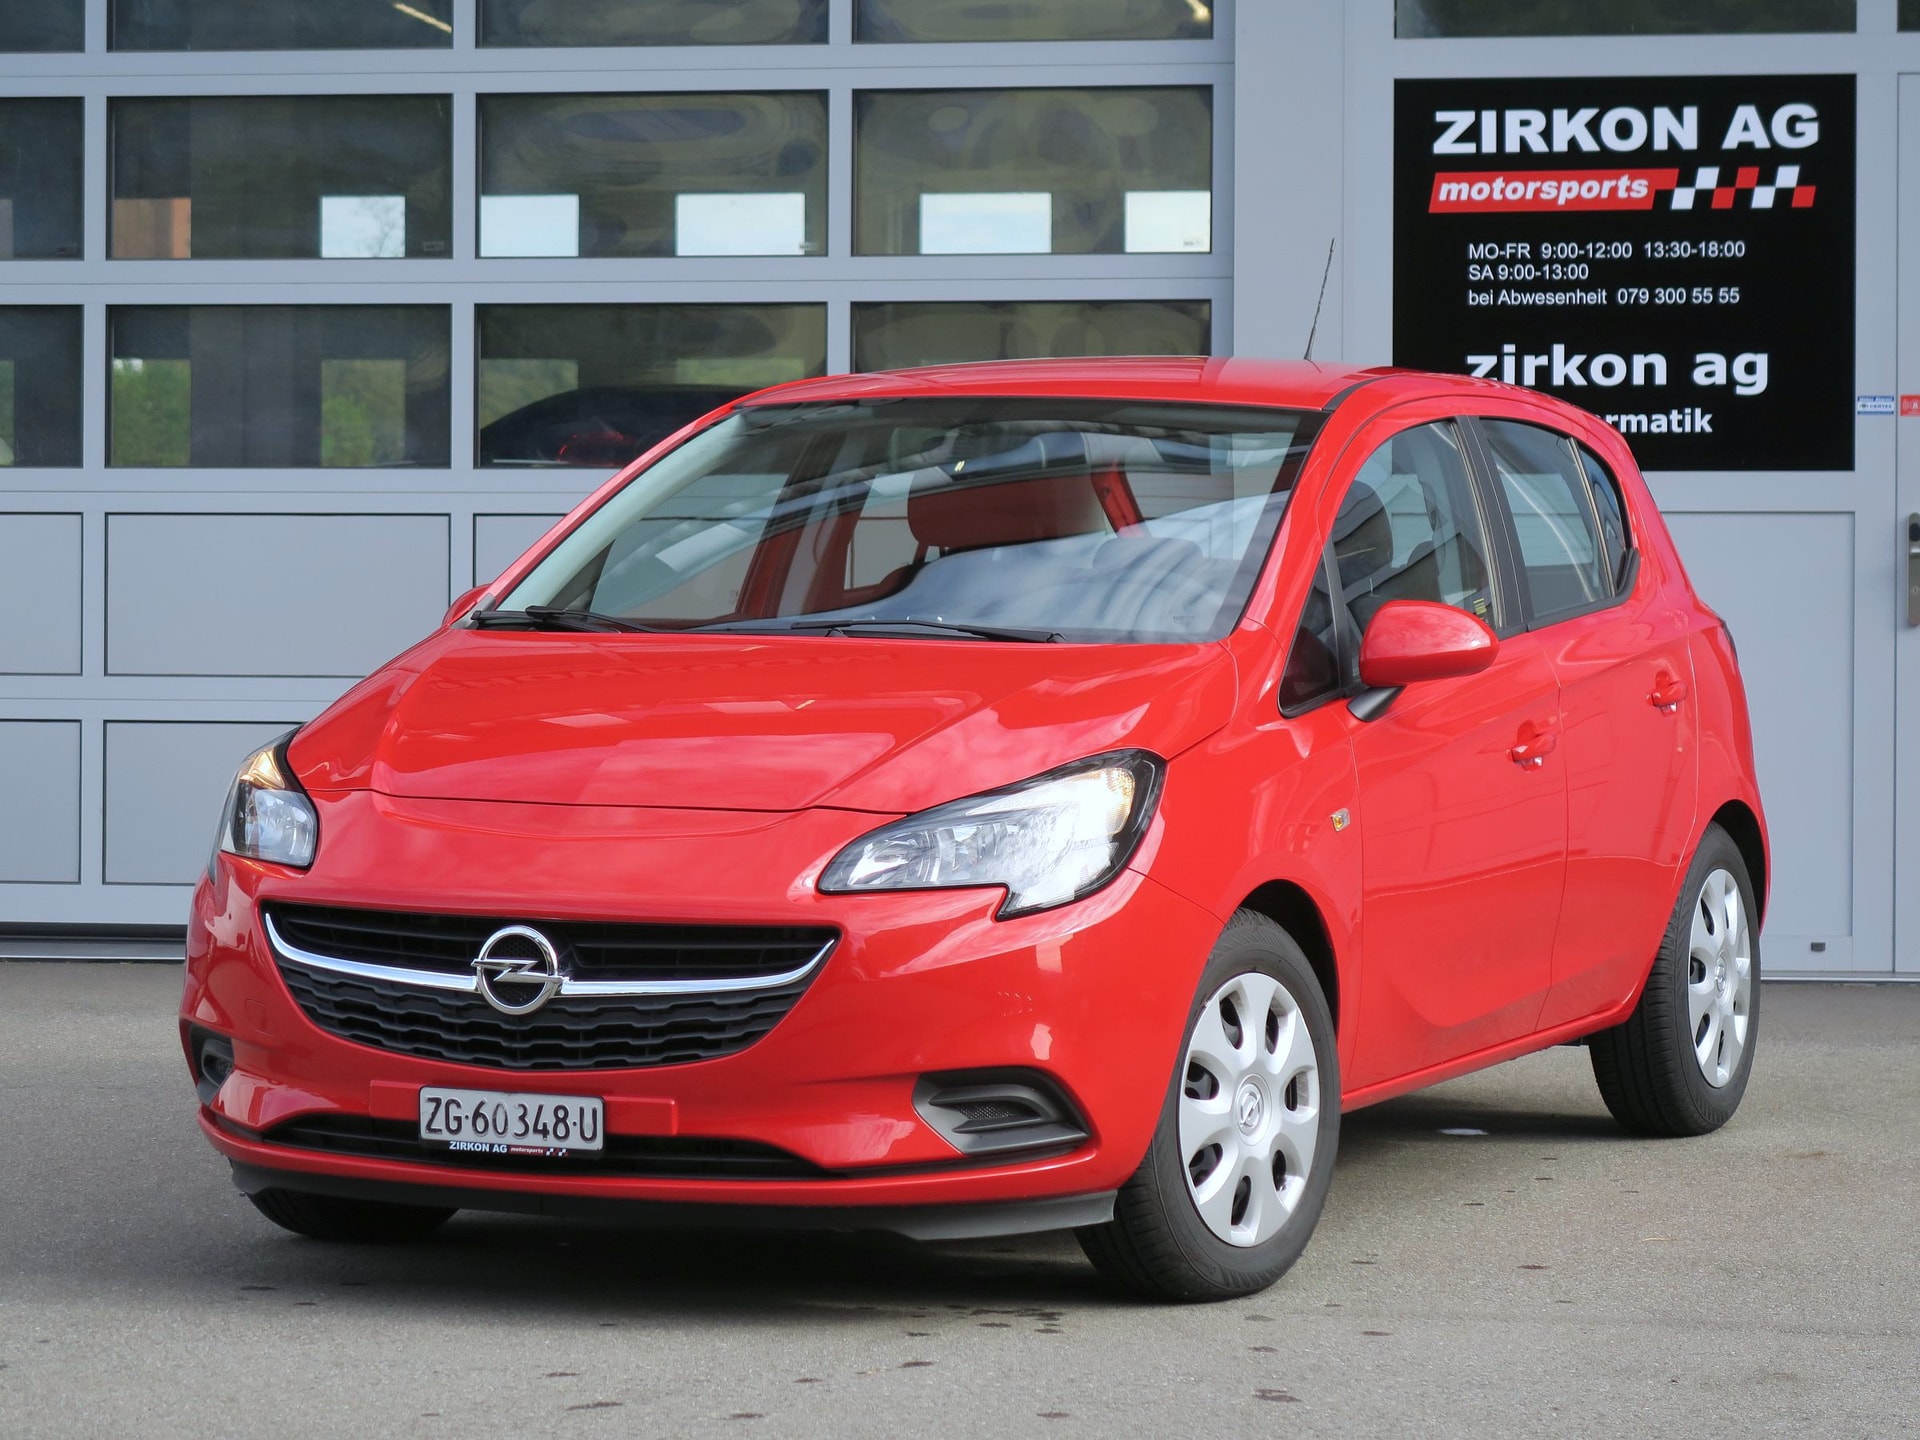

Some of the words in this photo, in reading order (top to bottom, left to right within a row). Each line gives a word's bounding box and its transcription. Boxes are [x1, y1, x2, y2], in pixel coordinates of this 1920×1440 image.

[1433, 106, 1698, 154] ZIRKON
[1721, 103, 1820, 150] AG
[1438, 174, 1649, 205] motorsports
[1469, 243, 1531, 260] MO-FR
[1541, 242, 1633, 259] 9:00-12:00
[1644, 241, 1746, 258] 13:30-18:00
[1468, 264, 1495, 281] SA
[1498, 263, 1589, 281] 9:00-13:00
[1468, 289, 1494, 306] bei
[1497, 288, 1608, 305] Abwesenheit
[1617, 287, 1650, 304] 079
[1655, 287, 1687, 304] 300
[1692, 287, 1713, 304] 55
[1718, 287, 1740, 304] 55
[1466, 343, 1667, 386] zirkon
[1692, 352, 1769, 396] ag
[1600, 407, 1713, 433] rmatik
[449, 1141, 490, 1152] ZIRKON
[493, 1144, 508, 1153] AG
